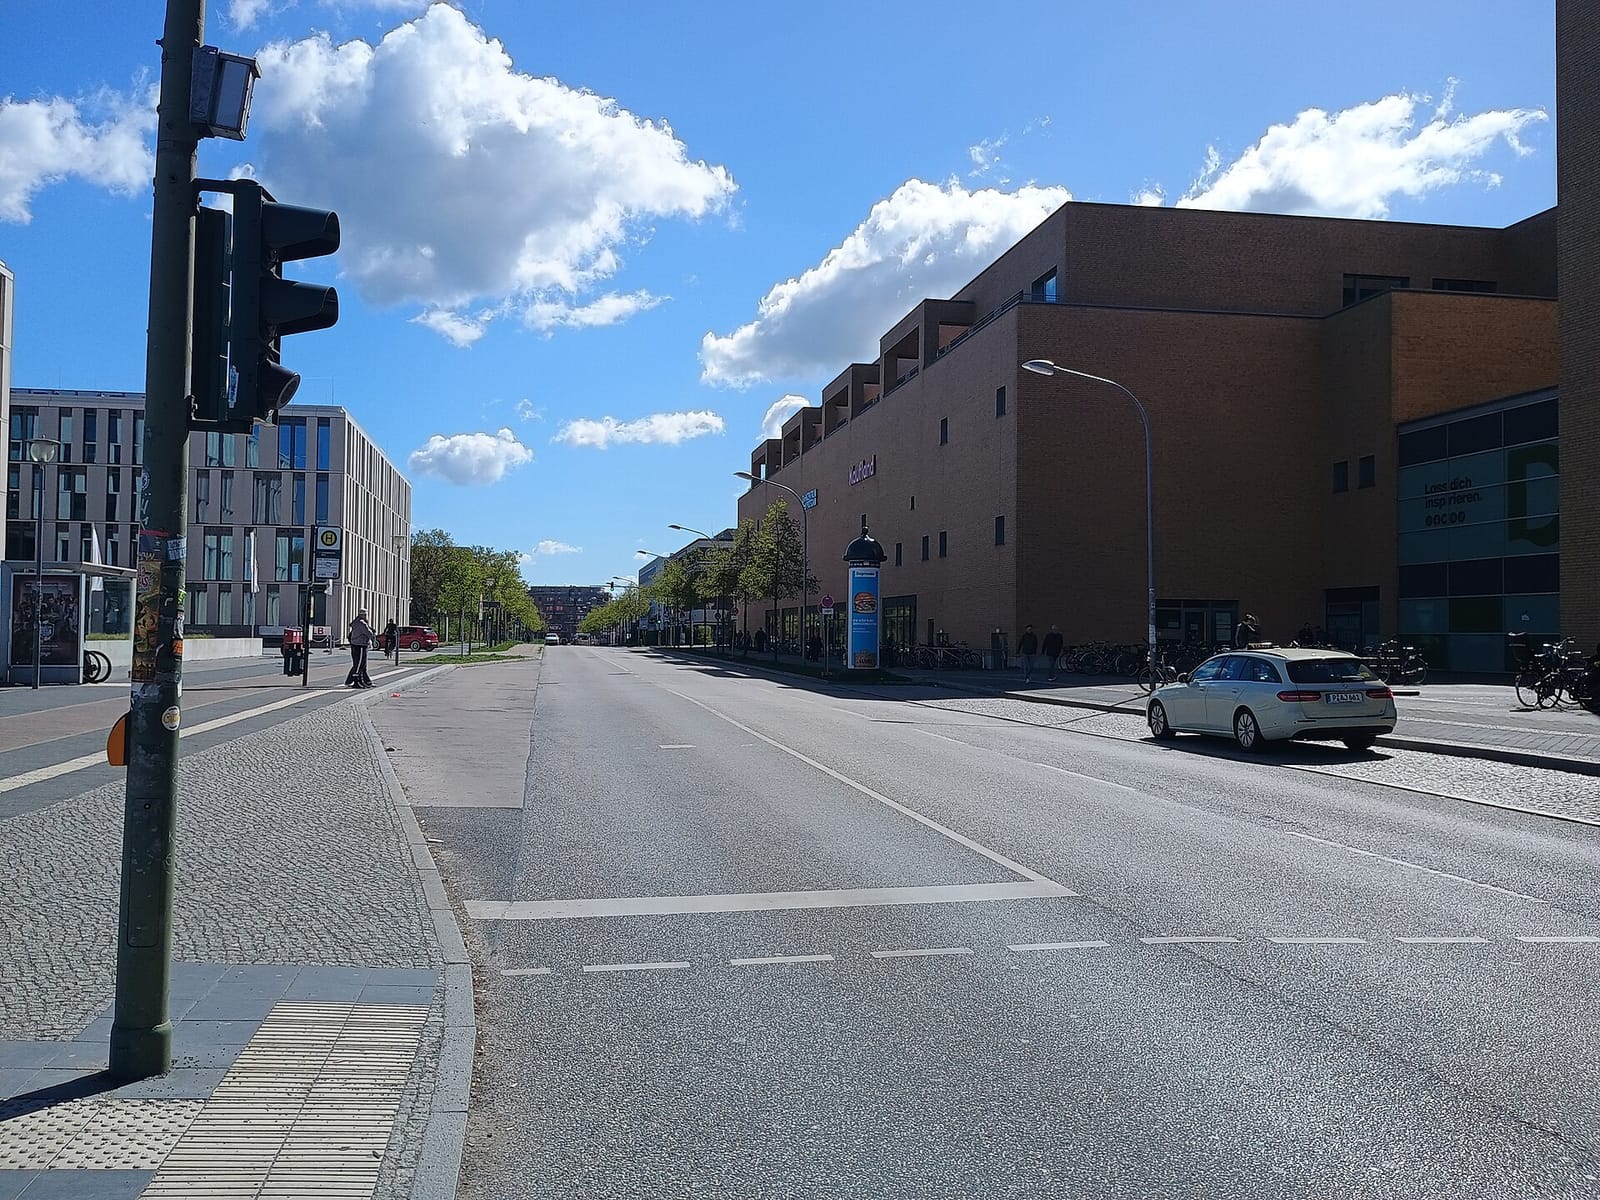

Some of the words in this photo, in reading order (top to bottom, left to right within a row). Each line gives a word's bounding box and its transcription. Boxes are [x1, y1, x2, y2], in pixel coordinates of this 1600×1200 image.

[1424, 481, 1448, 495] Lass
[1450, 475, 1472, 491] dich
[1424, 492, 1483, 510] insprieren.
